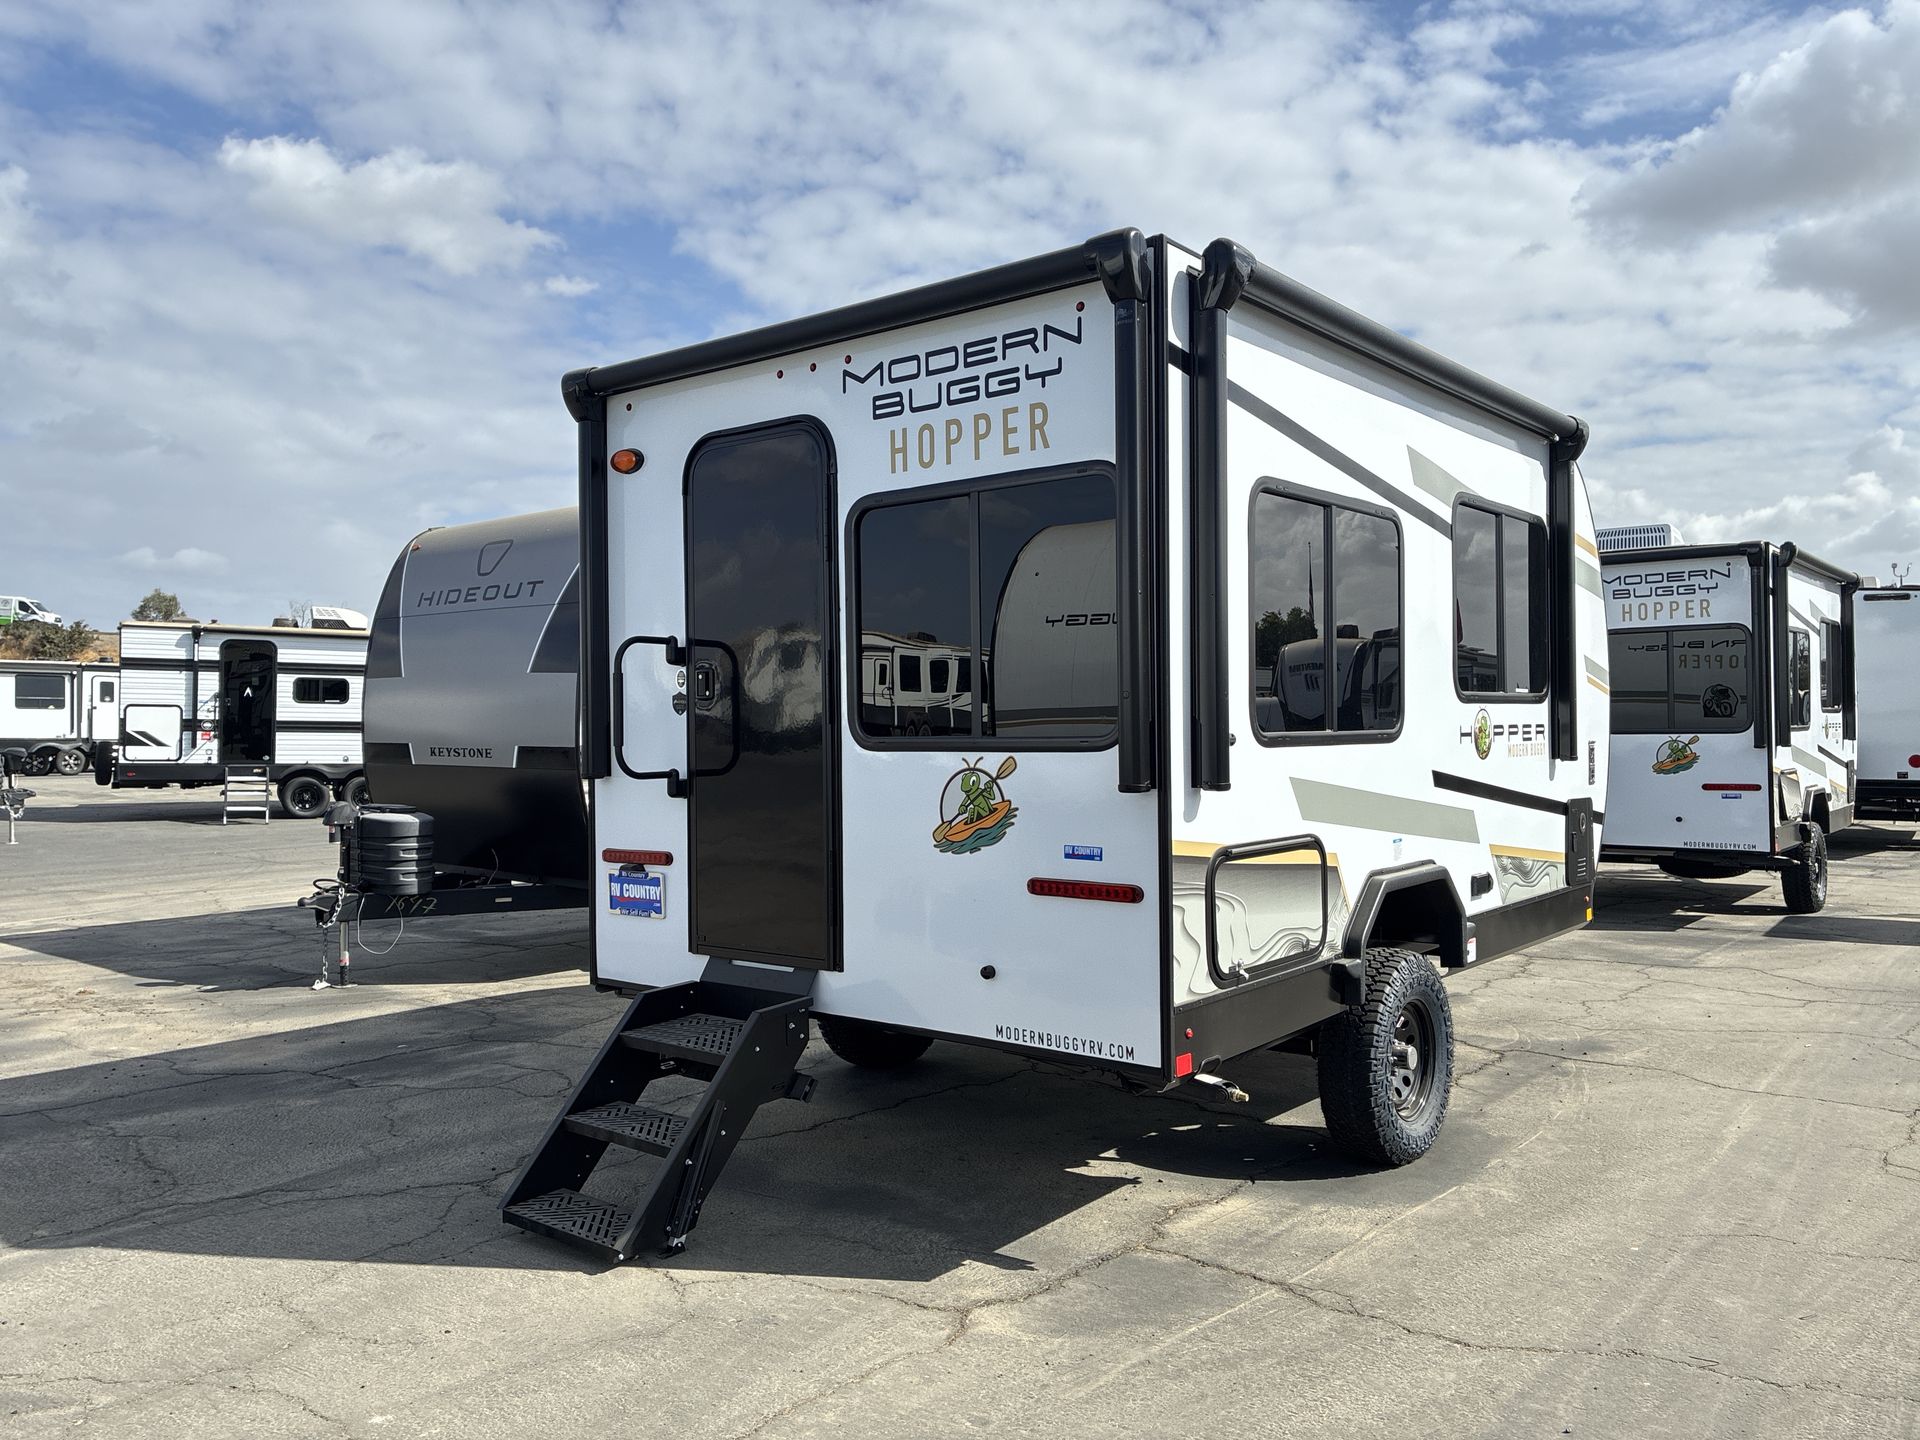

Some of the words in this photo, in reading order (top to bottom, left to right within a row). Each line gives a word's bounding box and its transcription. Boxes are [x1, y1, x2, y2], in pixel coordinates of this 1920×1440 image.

[843, 316, 1083, 394] MODERN
[872, 357, 1062, 420] BUGGY
[890, 402, 1050, 474] HOPPER
[1602, 567, 1731, 587] MODERN
[417, 580, 544, 608] HIDEOUT
[1612, 582, 1719, 600] BUGGY
[1622, 599, 1711, 622] HOPPER
[429, 746, 493, 759] KEYSTONE
[1683, 841, 1757, 850] MODERNBUGGYRV.COM
[610, 882, 621, 897] RV
[622, 883, 661, 900] COUNTRY
[995, 1024, 1135, 1061] MODERNBUGGYRV.COM
